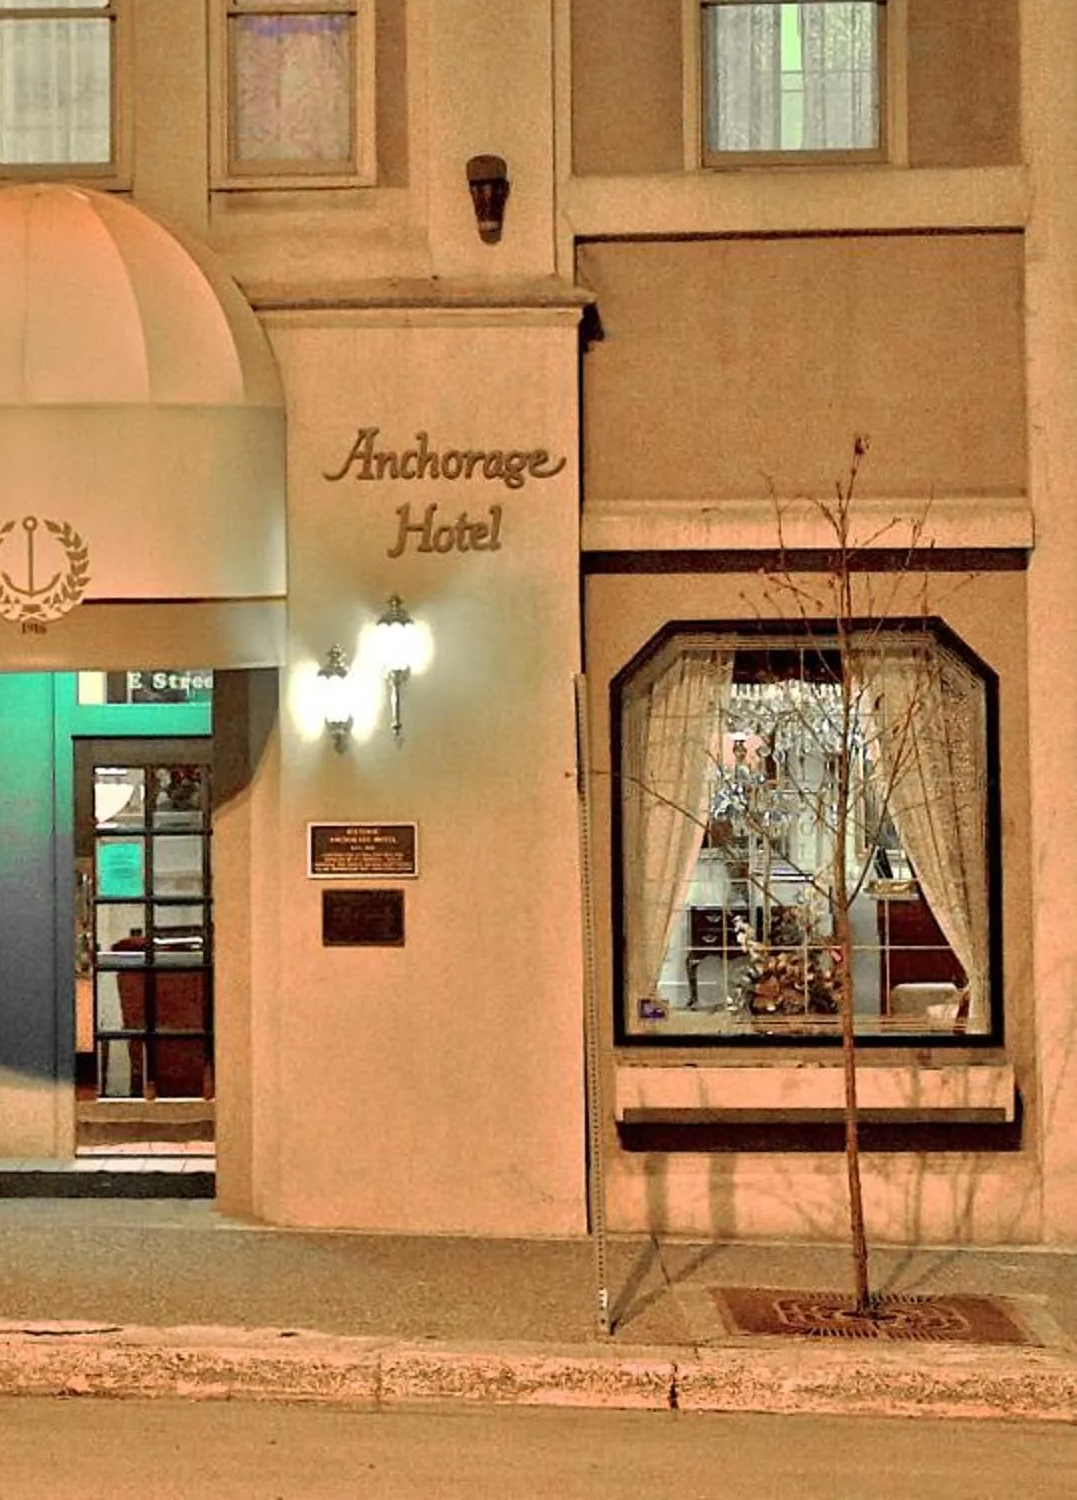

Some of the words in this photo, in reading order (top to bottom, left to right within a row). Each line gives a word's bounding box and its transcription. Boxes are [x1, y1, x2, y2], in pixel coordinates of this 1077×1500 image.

[323, 426, 566, 489] Anchorage
[386, 502, 502, 558] Hotel
[153, 672, 213, 689] Stree
